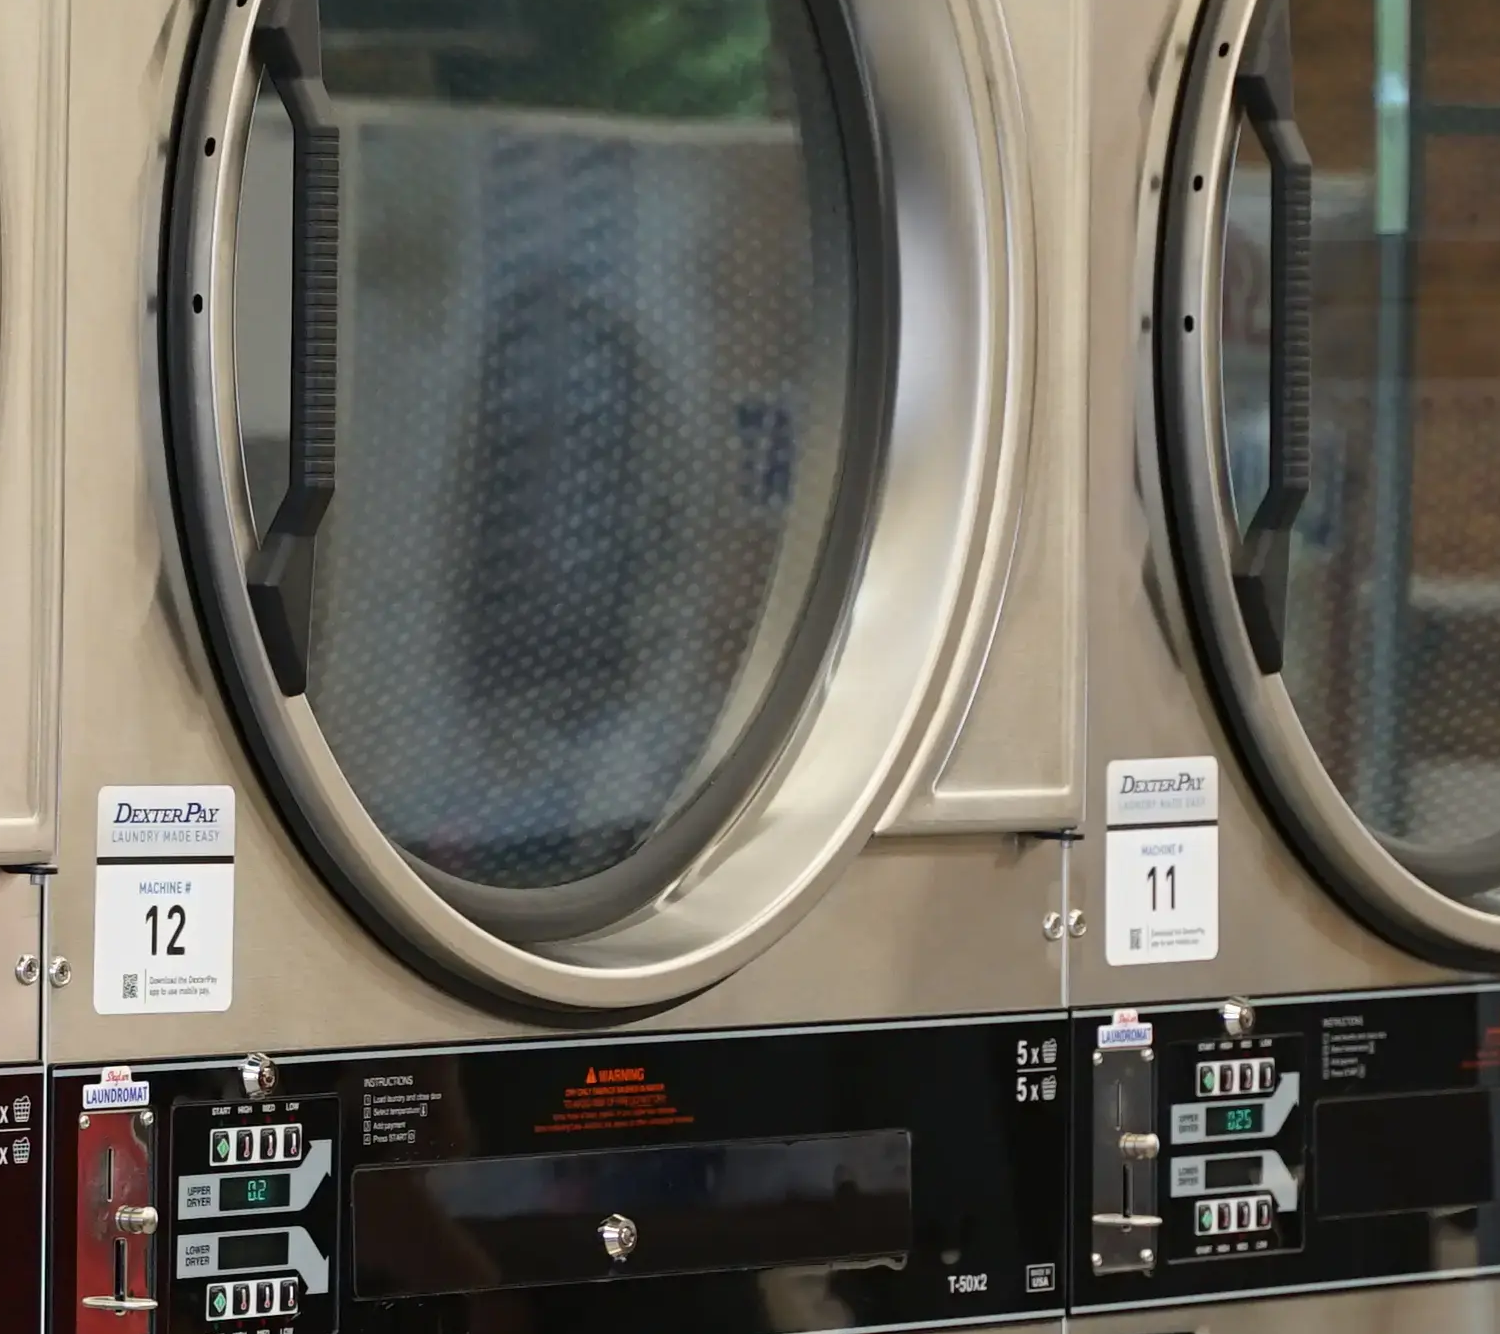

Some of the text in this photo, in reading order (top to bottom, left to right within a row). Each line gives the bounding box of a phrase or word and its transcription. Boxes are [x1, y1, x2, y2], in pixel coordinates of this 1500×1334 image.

[112, 830, 220, 843] LAUNDRY MADE EASY
[139, 882, 192, 894] MACHINE #
[1147, 865, 1175, 911] 11
[145, 904, 186, 956] 12
[1017, 1040, 1039, 1065] 5 x
[598, 1067, 645, 1082] WARNING
[86, 1086, 147, 1104] LAUNDROMAT
[1016, 1077, 1039, 1101] 5 x
[0, 1106, 8, 1123] x
[212, 1106, 231, 1116] START
[286, 1103, 299, 1112] LOW
[0, 1147, 8, 1164] x
[187, 1186, 211, 1196] UPPER
[187, 1198, 211, 1207] DRYER
[185, 1256, 209, 1267] DRYER
[948, 1274, 987, 1293] T-50X2
